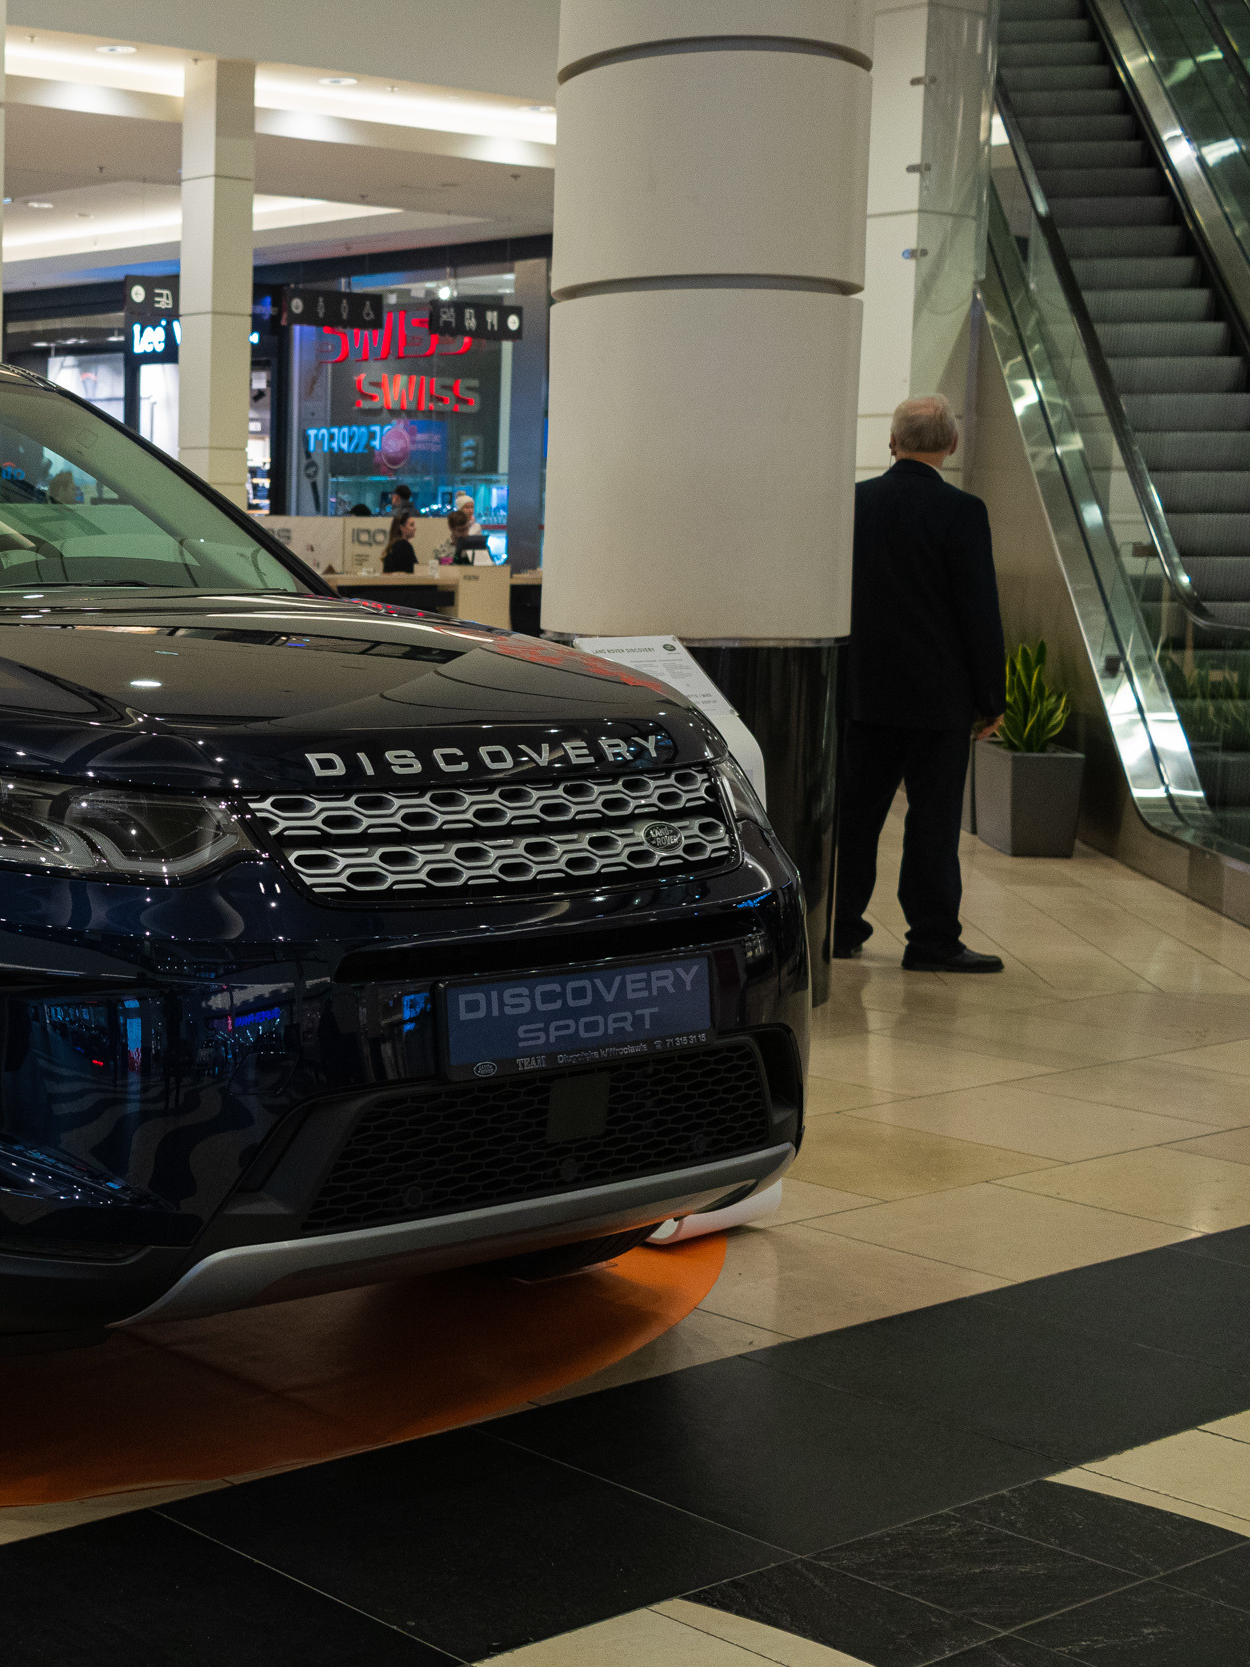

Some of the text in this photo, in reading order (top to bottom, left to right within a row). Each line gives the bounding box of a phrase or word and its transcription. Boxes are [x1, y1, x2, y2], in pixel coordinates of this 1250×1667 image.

[354, 373, 481, 414] SWISS
[351, 528, 389, 547] IQO
[305, 735, 658, 778] DISCOVERY
[649, 826, 670, 838] LAND
[656, 834, 680, 847] ROVER
[458, 964, 701, 1021] DISCOVERY
[516, 1007, 659, 1047] SPORT
[516, 1055, 548, 1071] TEAM
[665, 1038, 675, 1049] 71
